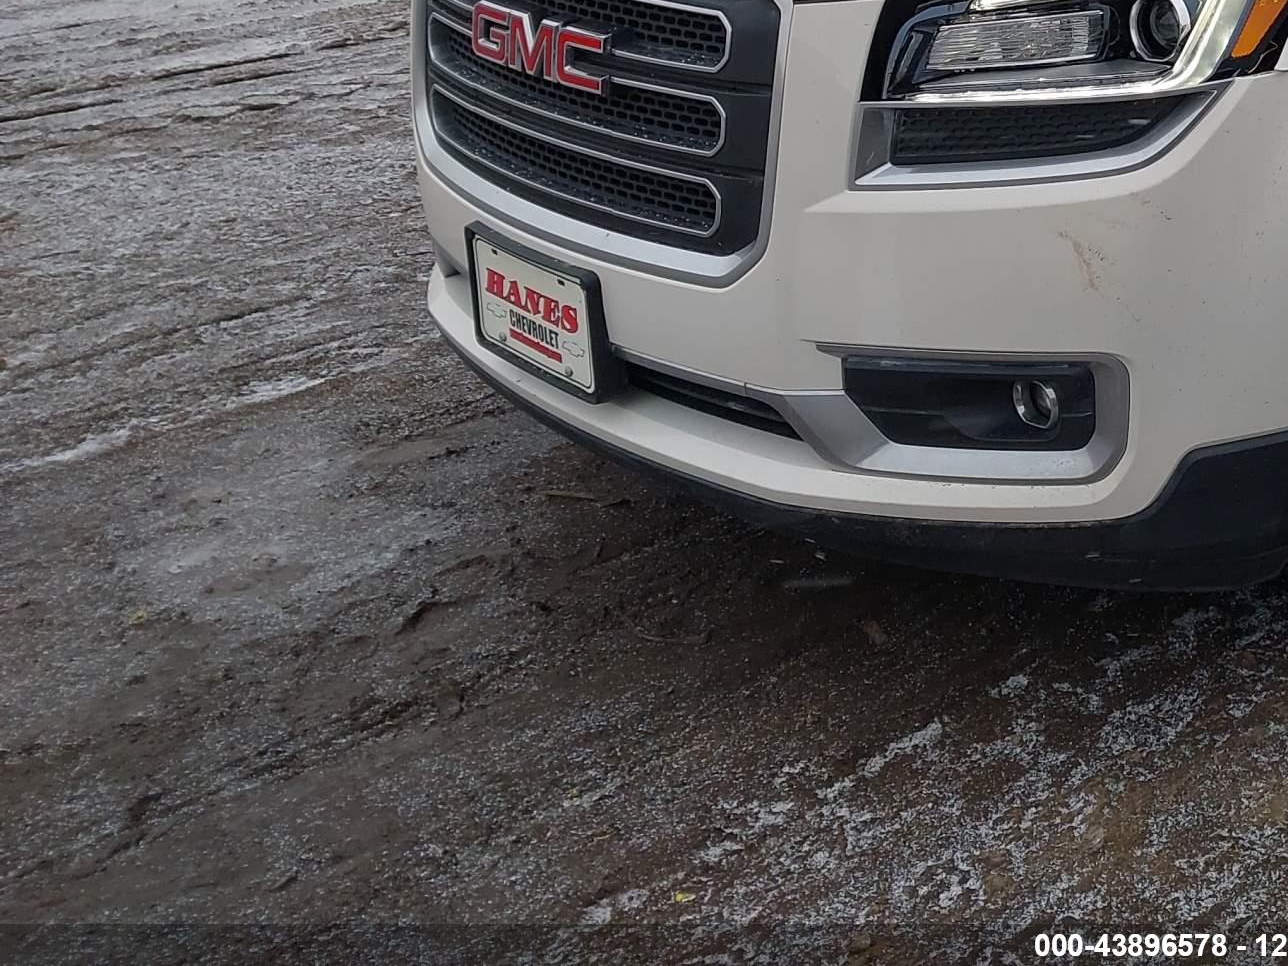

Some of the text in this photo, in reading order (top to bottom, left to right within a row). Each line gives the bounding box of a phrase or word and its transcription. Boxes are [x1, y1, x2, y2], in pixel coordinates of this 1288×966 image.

[472, 0, 609, 95] GMC
[486, 267, 578, 333] HANES
[509, 309, 559, 349] CHEVROLET
